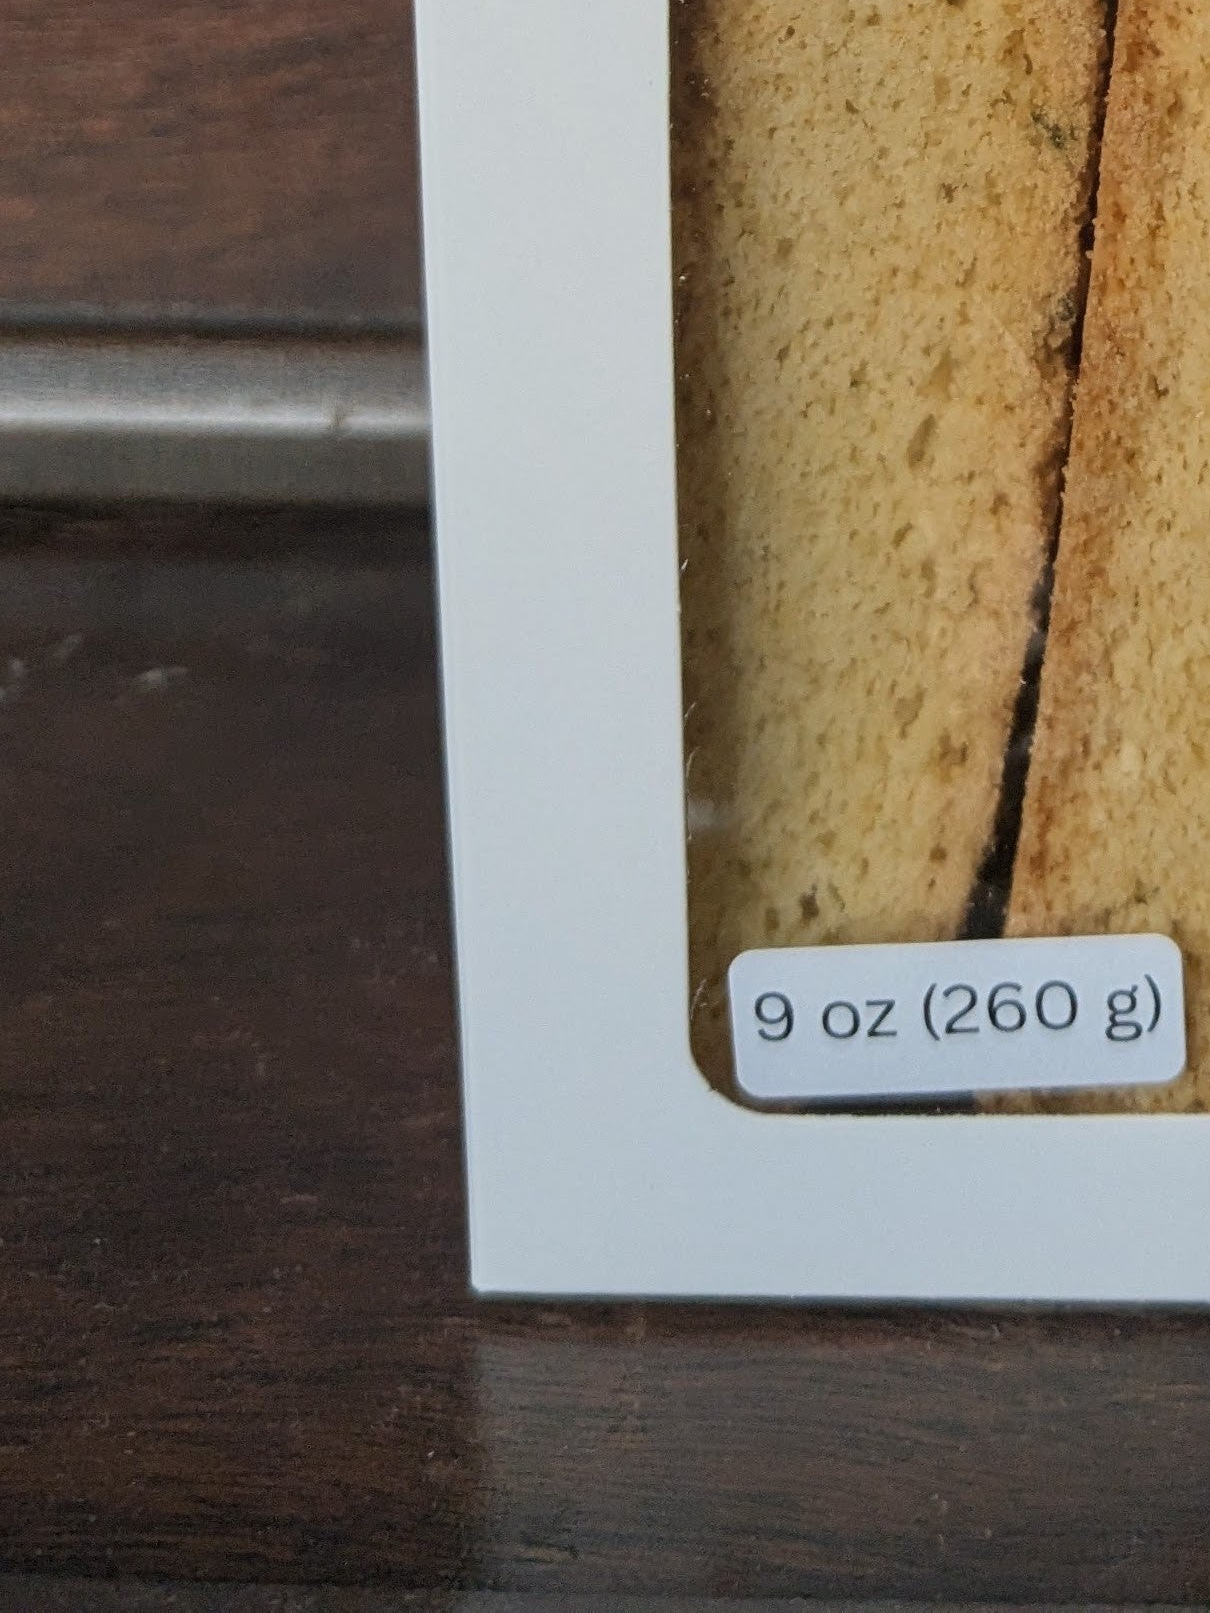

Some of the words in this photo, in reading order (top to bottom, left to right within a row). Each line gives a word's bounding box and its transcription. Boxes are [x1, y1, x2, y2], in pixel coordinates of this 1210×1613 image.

[753, 991, 795, 1042] 9
[822, 998, 898, 1039] oz
[923, 979, 1079, 1041] (260
[1105, 974, 1161, 1042] g)
